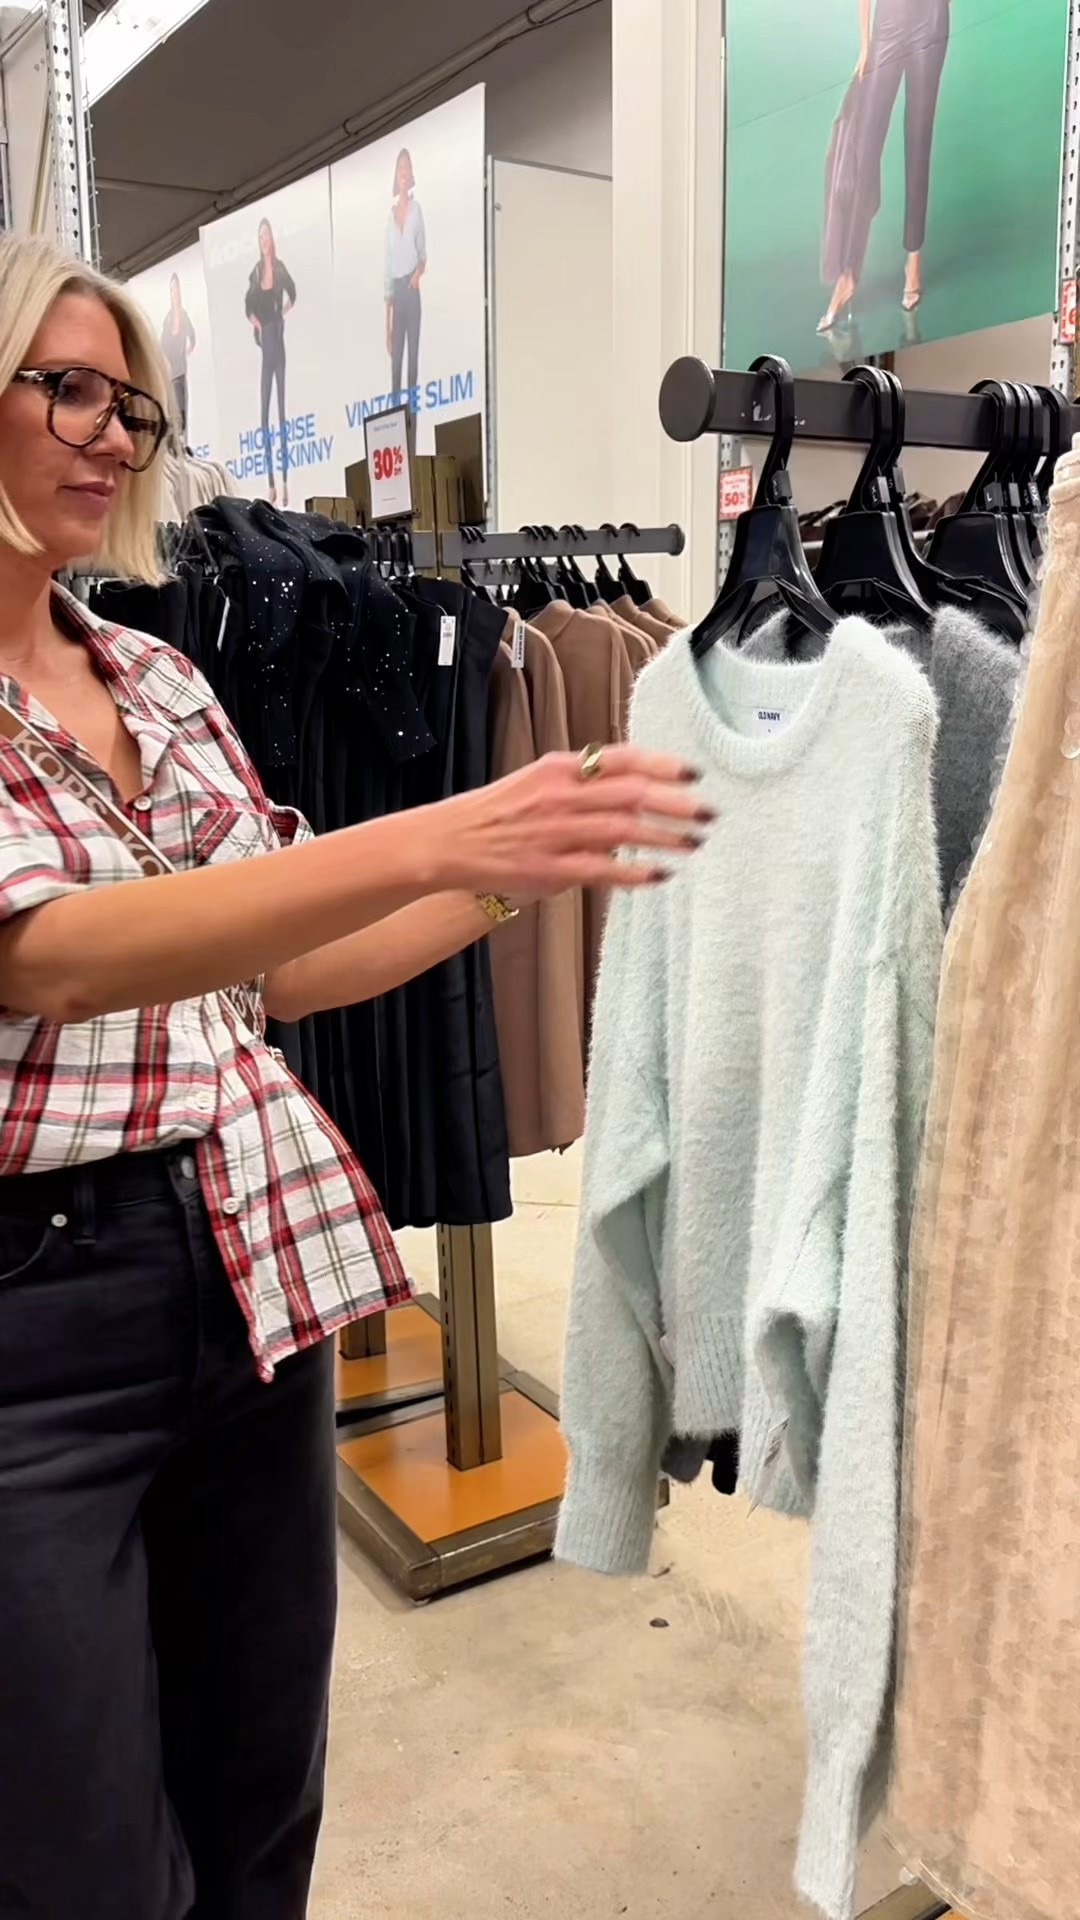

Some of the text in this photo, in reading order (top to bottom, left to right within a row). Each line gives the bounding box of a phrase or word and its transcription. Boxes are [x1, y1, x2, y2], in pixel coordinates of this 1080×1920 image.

[425, 370, 473, 408] SLIM
[239, 413, 315, 454] HIGH-RISE
[225, 435, 333, 479] SUPER SKINNY
[373, 445, 403, 480] 30%
